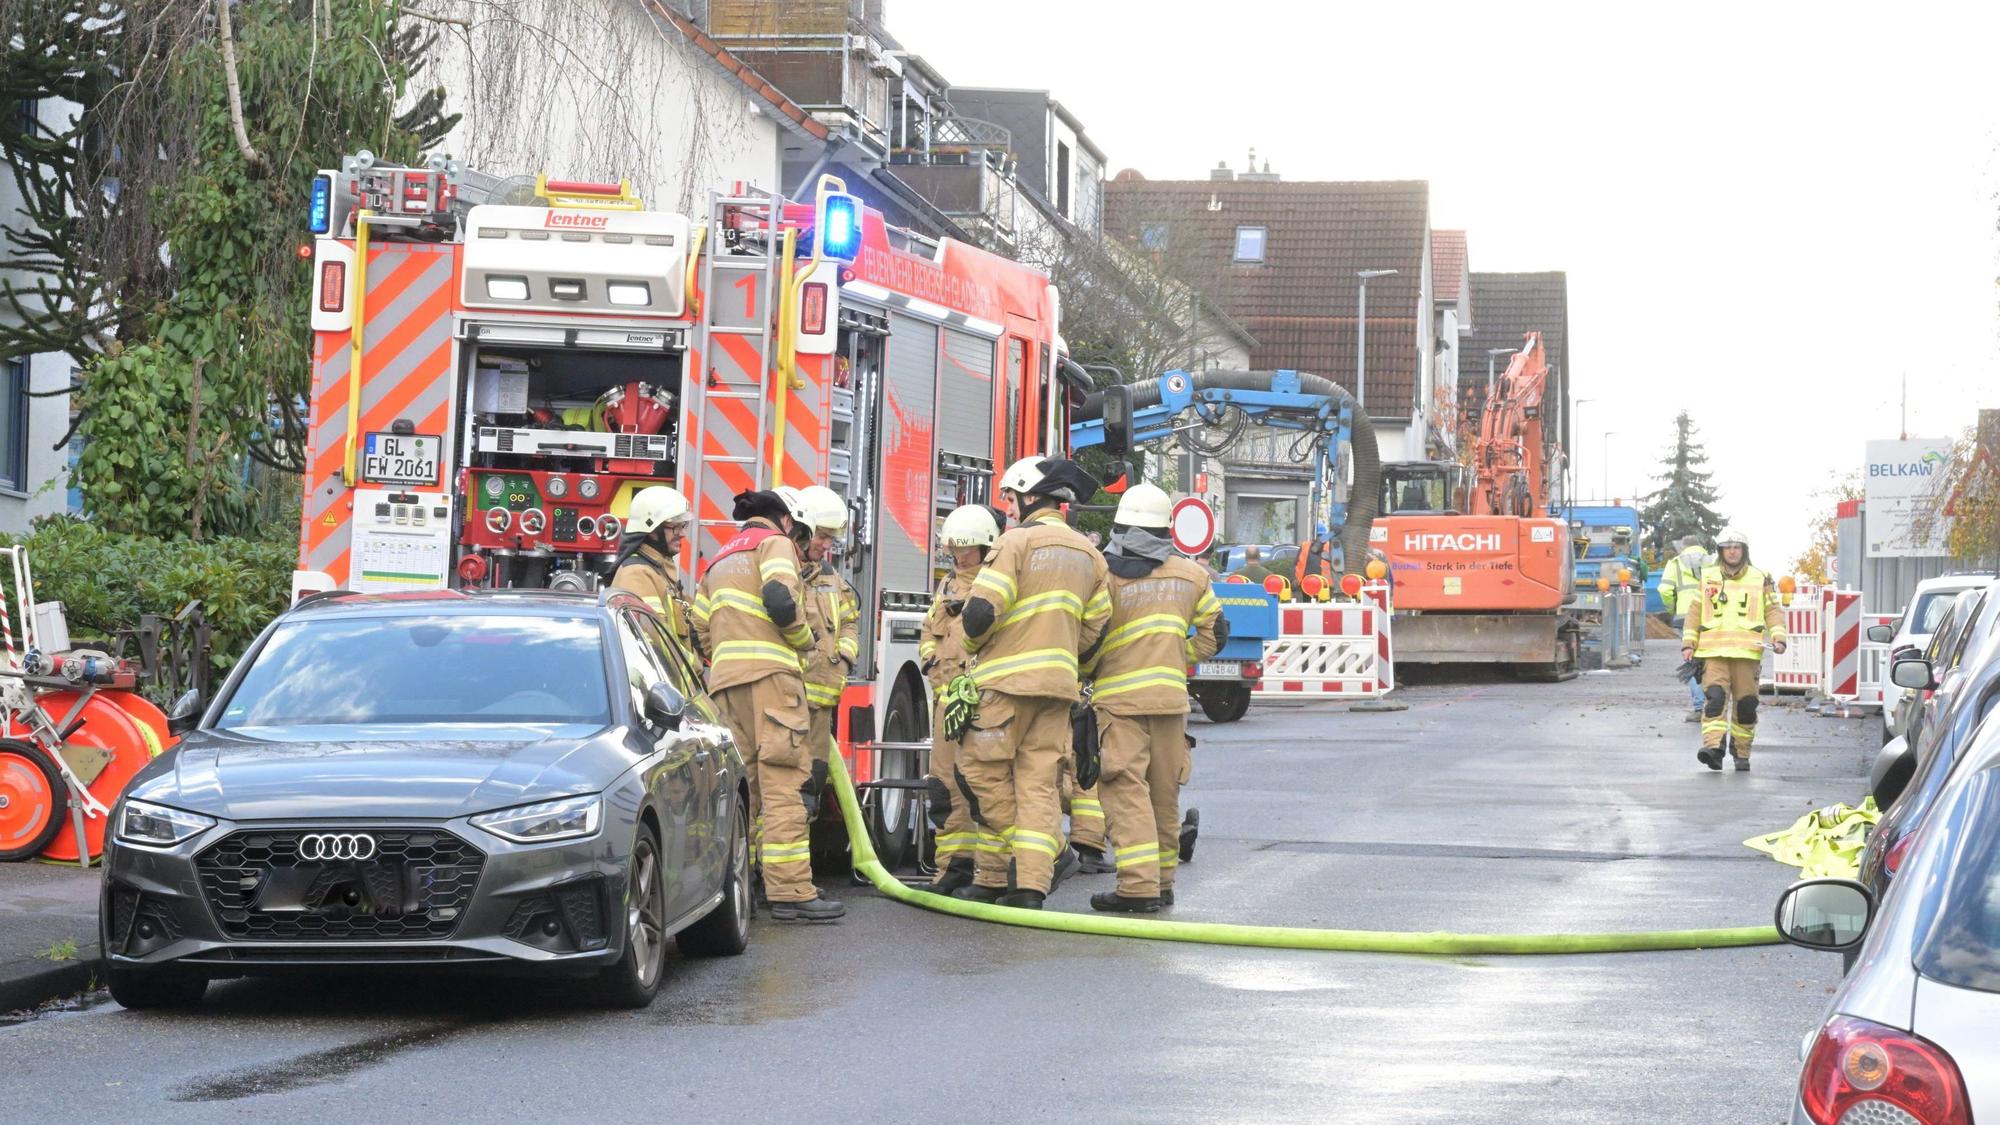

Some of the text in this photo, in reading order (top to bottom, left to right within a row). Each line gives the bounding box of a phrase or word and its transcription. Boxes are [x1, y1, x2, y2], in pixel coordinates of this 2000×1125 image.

[863, 245, 913, 293] FEUERWEHR
[734, 271, 757, 320] 1
[384, 438, 405, 456] GL
[367, 457, 434, 478] FW 2061
[1869, 463, 1933, 477] BELKAW
[1404, 533, 1501, 551] HITACHI
[1426, 561, 1453, 571] Stark
[1456, 562, 1466, 571] in
[1490, 561, 1513, 571] Tiefe
